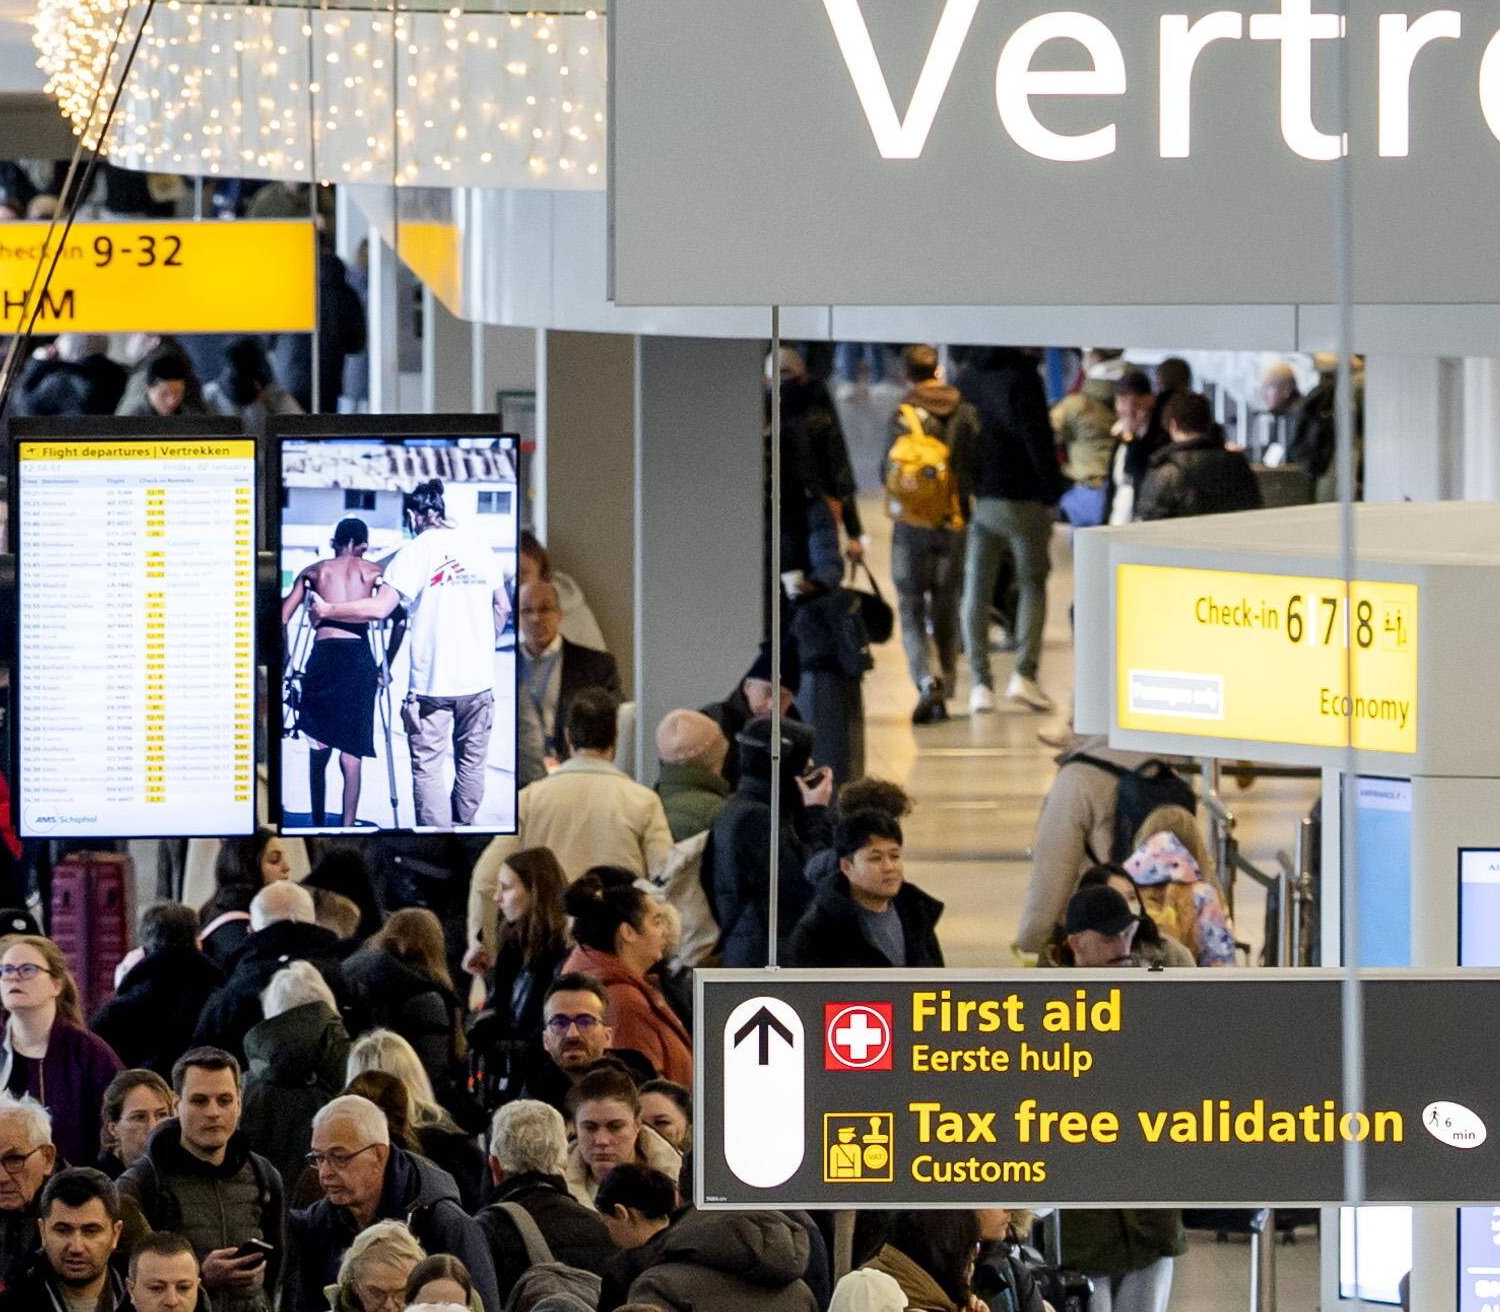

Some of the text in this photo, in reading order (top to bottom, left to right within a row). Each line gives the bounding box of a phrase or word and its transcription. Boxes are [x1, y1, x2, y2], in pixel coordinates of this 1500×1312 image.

[94, 235, 183, 267] 9-32
[42, 447, 230, 460] Flight departures Vertrekken
[1195, 595, 1303, 643] Check-in 6
[1321, 598, 1337, 645] 7
[1356, 600, 1373, 648] 8
[1320, 687, 1410, 729] Economy
[911, 990, 1122, 1033] First aid
[911, 1043, 1093, 1077] Eerste hulp
[910, 1099, 1404, 1145] Tax free validation
[1453, 1129, 1477, 1141] min
[911, 1154, 1047, 1184] Customs
